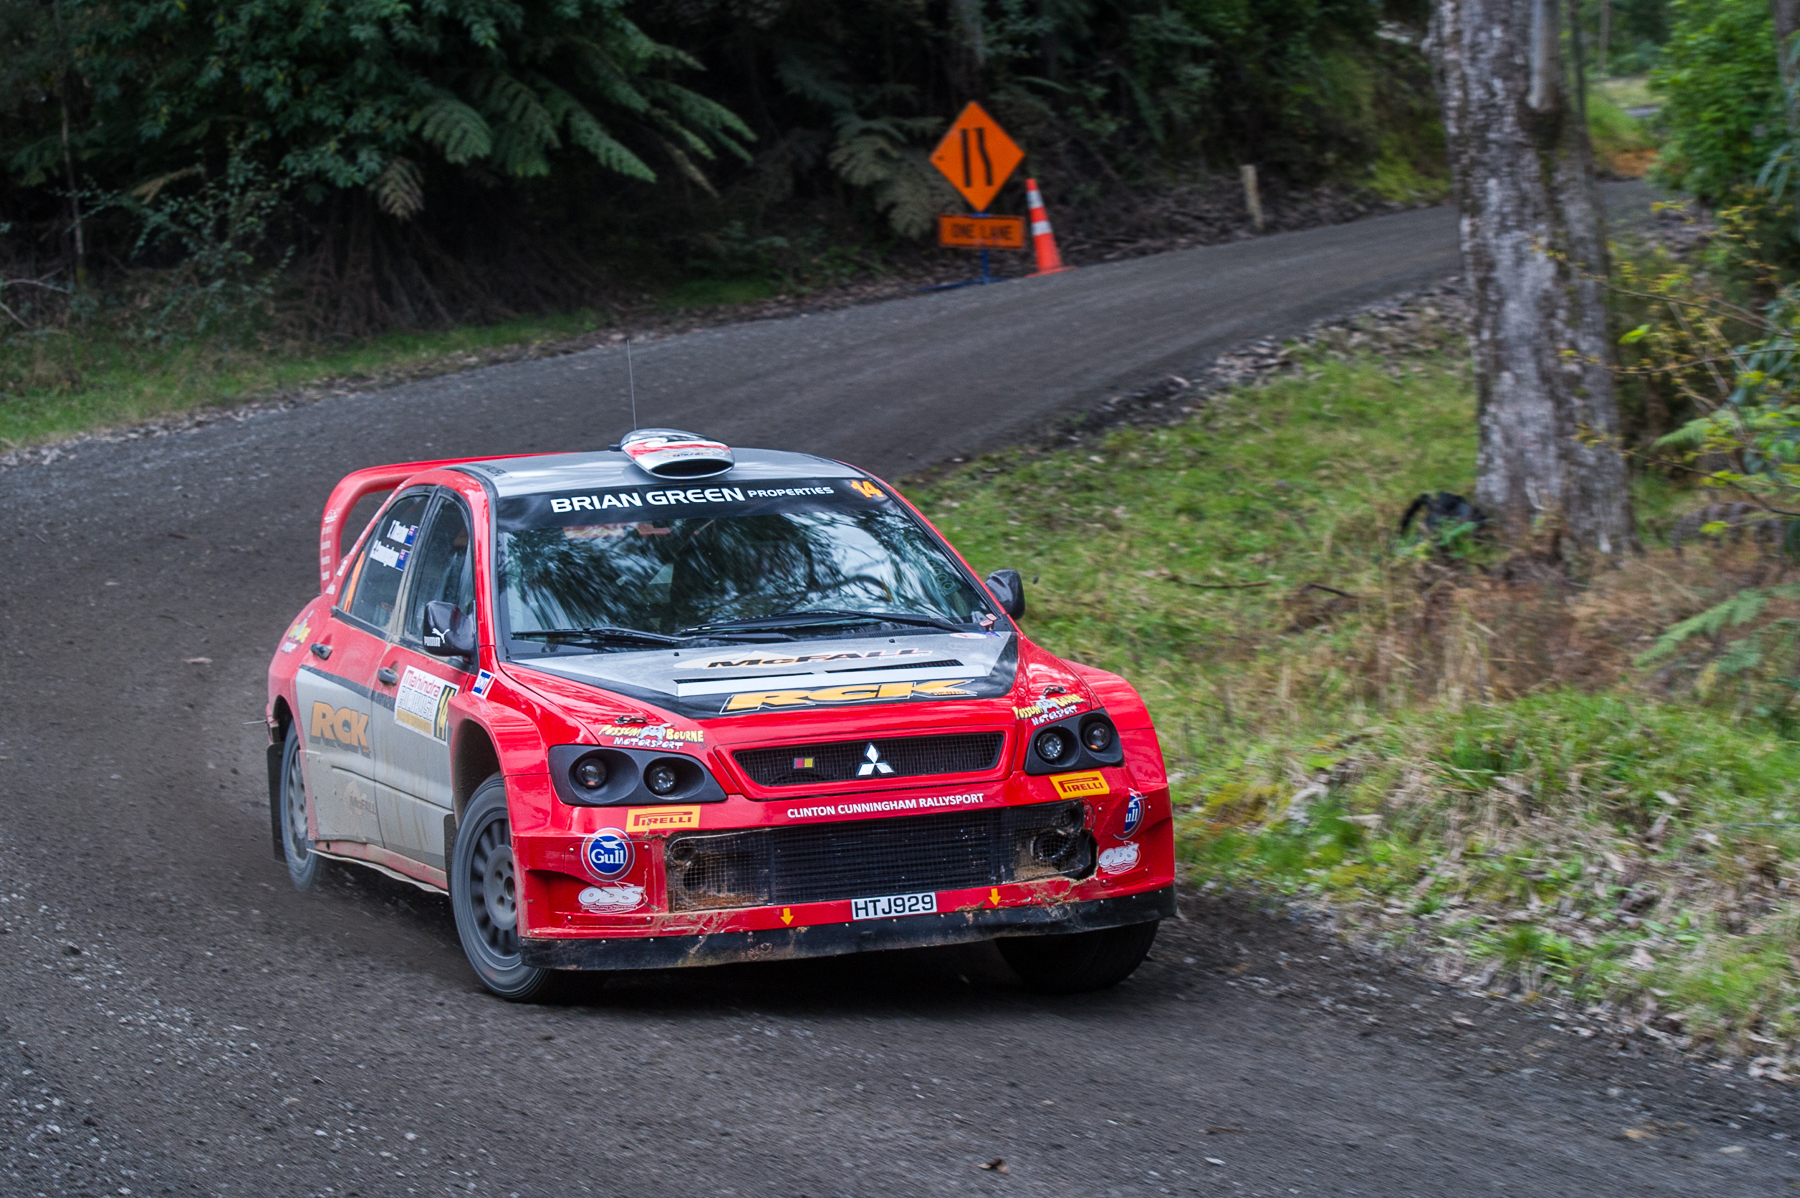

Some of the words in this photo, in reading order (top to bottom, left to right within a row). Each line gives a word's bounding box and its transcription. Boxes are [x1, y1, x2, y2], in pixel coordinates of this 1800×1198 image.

[951, 223, 975, 239] ONE
[980, 225, 1013, 240] LANE
[550, 492, 643, 513] BRIAN
[646, 487, 746, 506] GREEN
[747, 486, 835, 498] PROPERTIES
[851, 480, 885, 498] 14
[403, 669, 441, 698] Mahindra
[722, 679, 972, 711] RCK
[436, 687, 456, 740] 14
[1031, 705, 1078, 726] MOTORSPORT
[310, 700, 371, 754] RCK
[598, 725, 642, 737] POSSUM
[665, 728, 704, 742] BOURNE
[613, 737, 684, 750] MOTORSPORT
[1058, 777, 1104, 793] PIRELLI
[787, 804, 835, 818] CLINTON
[837, 798, 917, 815] CUNNINGHAM
[918, 793, 985, 809] RALLYSPORT
[633, 811, 693, 827] PIRELLI
[590, 848, 625, 864] Gull
[853, 894, 934, 918] HTJ929
